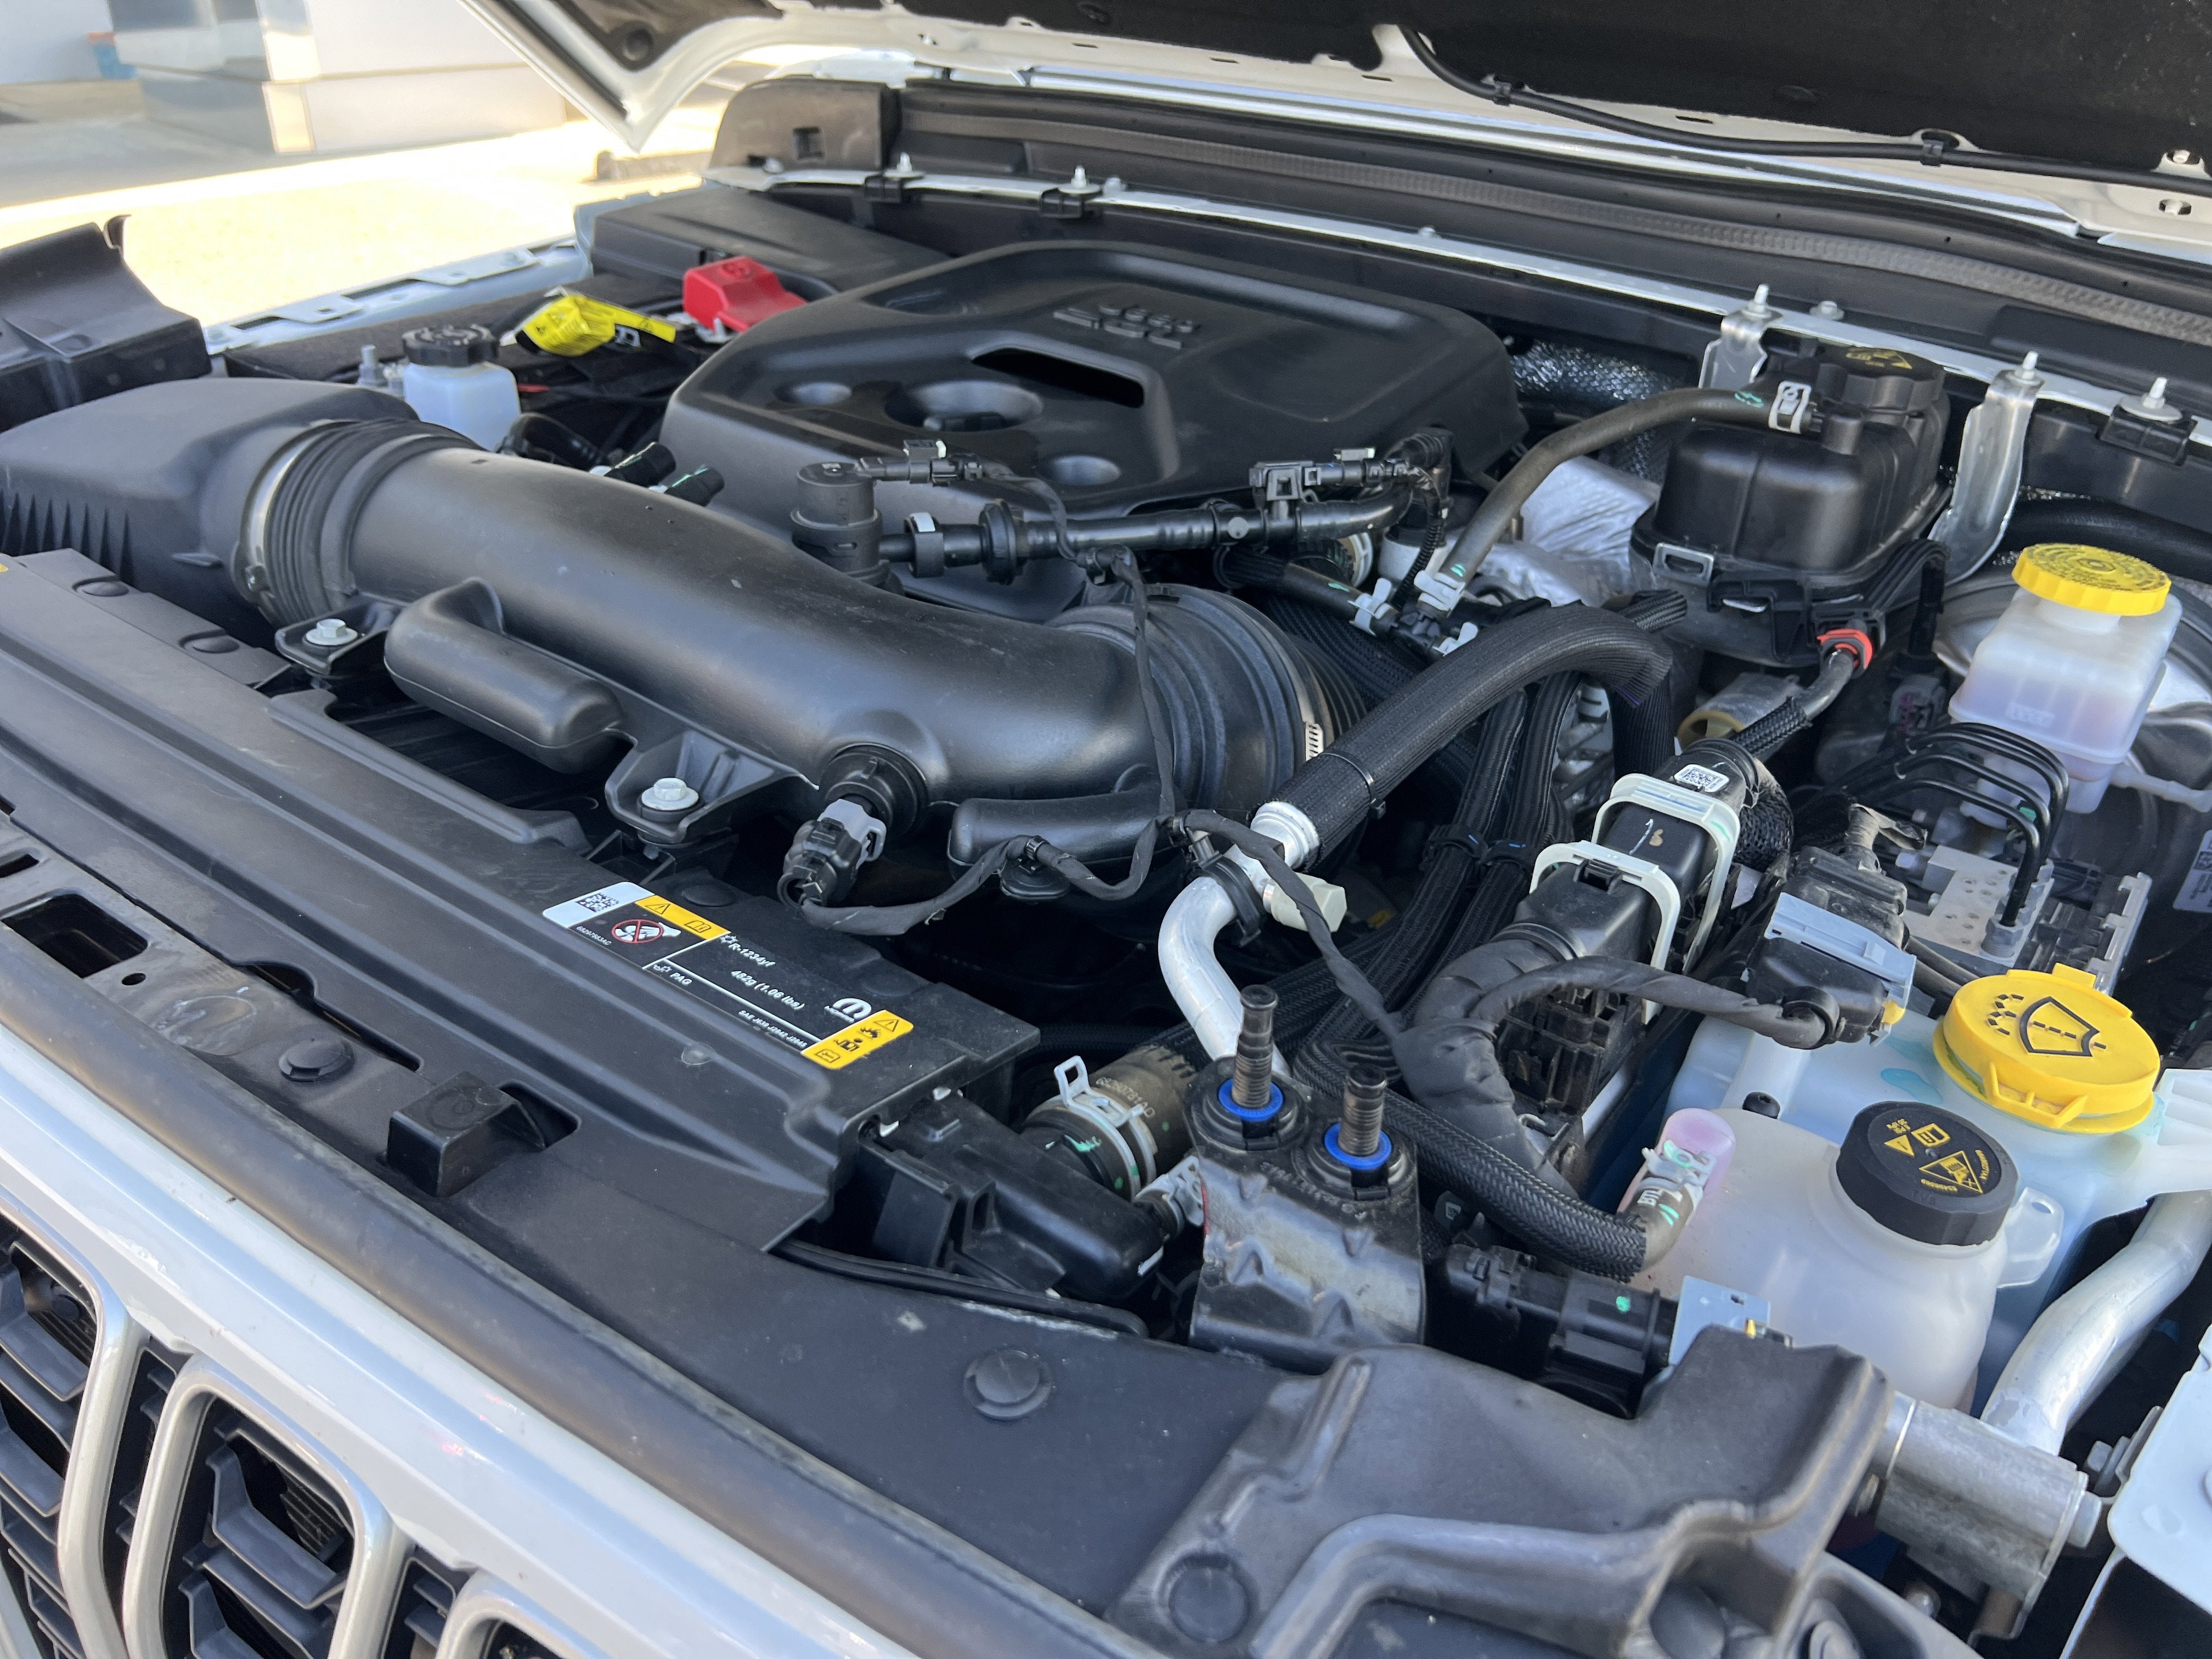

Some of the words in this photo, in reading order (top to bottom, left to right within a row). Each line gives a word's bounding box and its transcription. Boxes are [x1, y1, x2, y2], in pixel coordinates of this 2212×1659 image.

[728, 943, 776, 968] R-1234yf
[670, 972, 692, 986] PAG
[731, 970, 758, 987] 482g
[754, 983, 785, 999] (1.06
[781, 995, 805, 1011] lbs)
[738, 1010, 755, 1021] SAE
